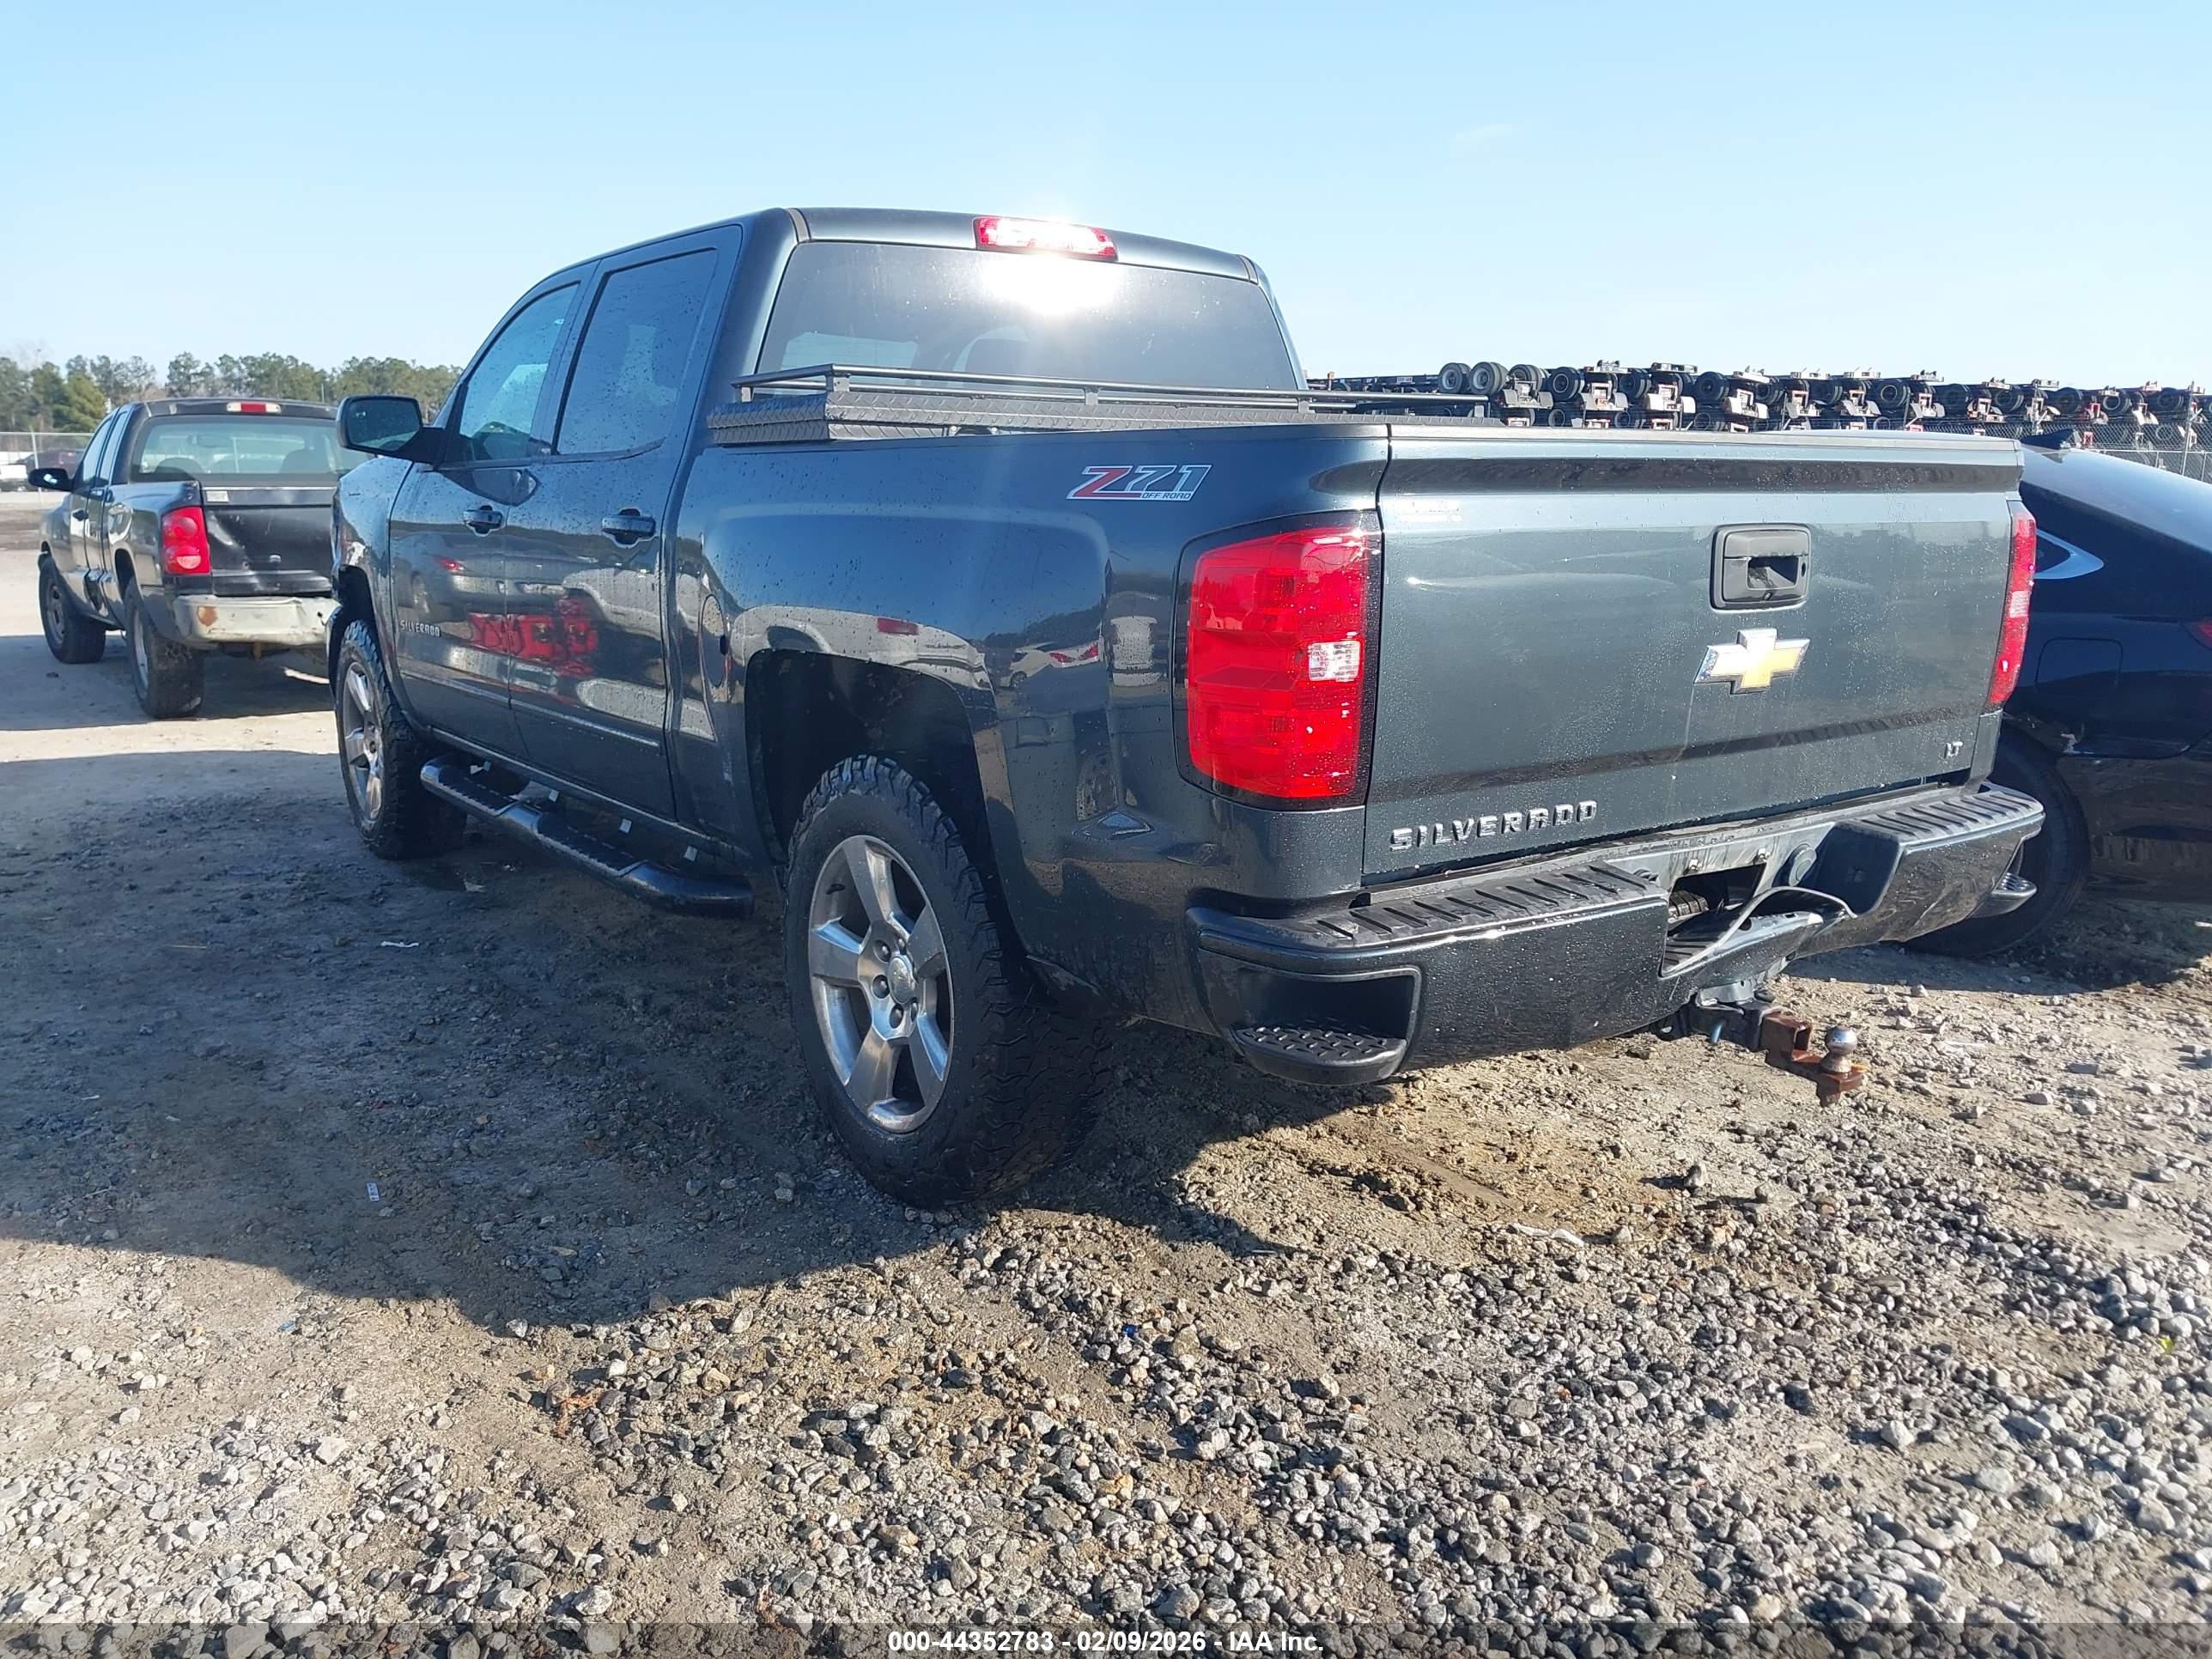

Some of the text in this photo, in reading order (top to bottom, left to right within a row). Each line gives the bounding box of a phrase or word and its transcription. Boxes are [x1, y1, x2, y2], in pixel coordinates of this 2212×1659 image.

[1066, 465, 1212, 500] Z71
[400, 619, 441, 637] SILVERADO
[1943, 741, 1964, 758] LT
[1389, 799, 1597, 852] SILVERADO
